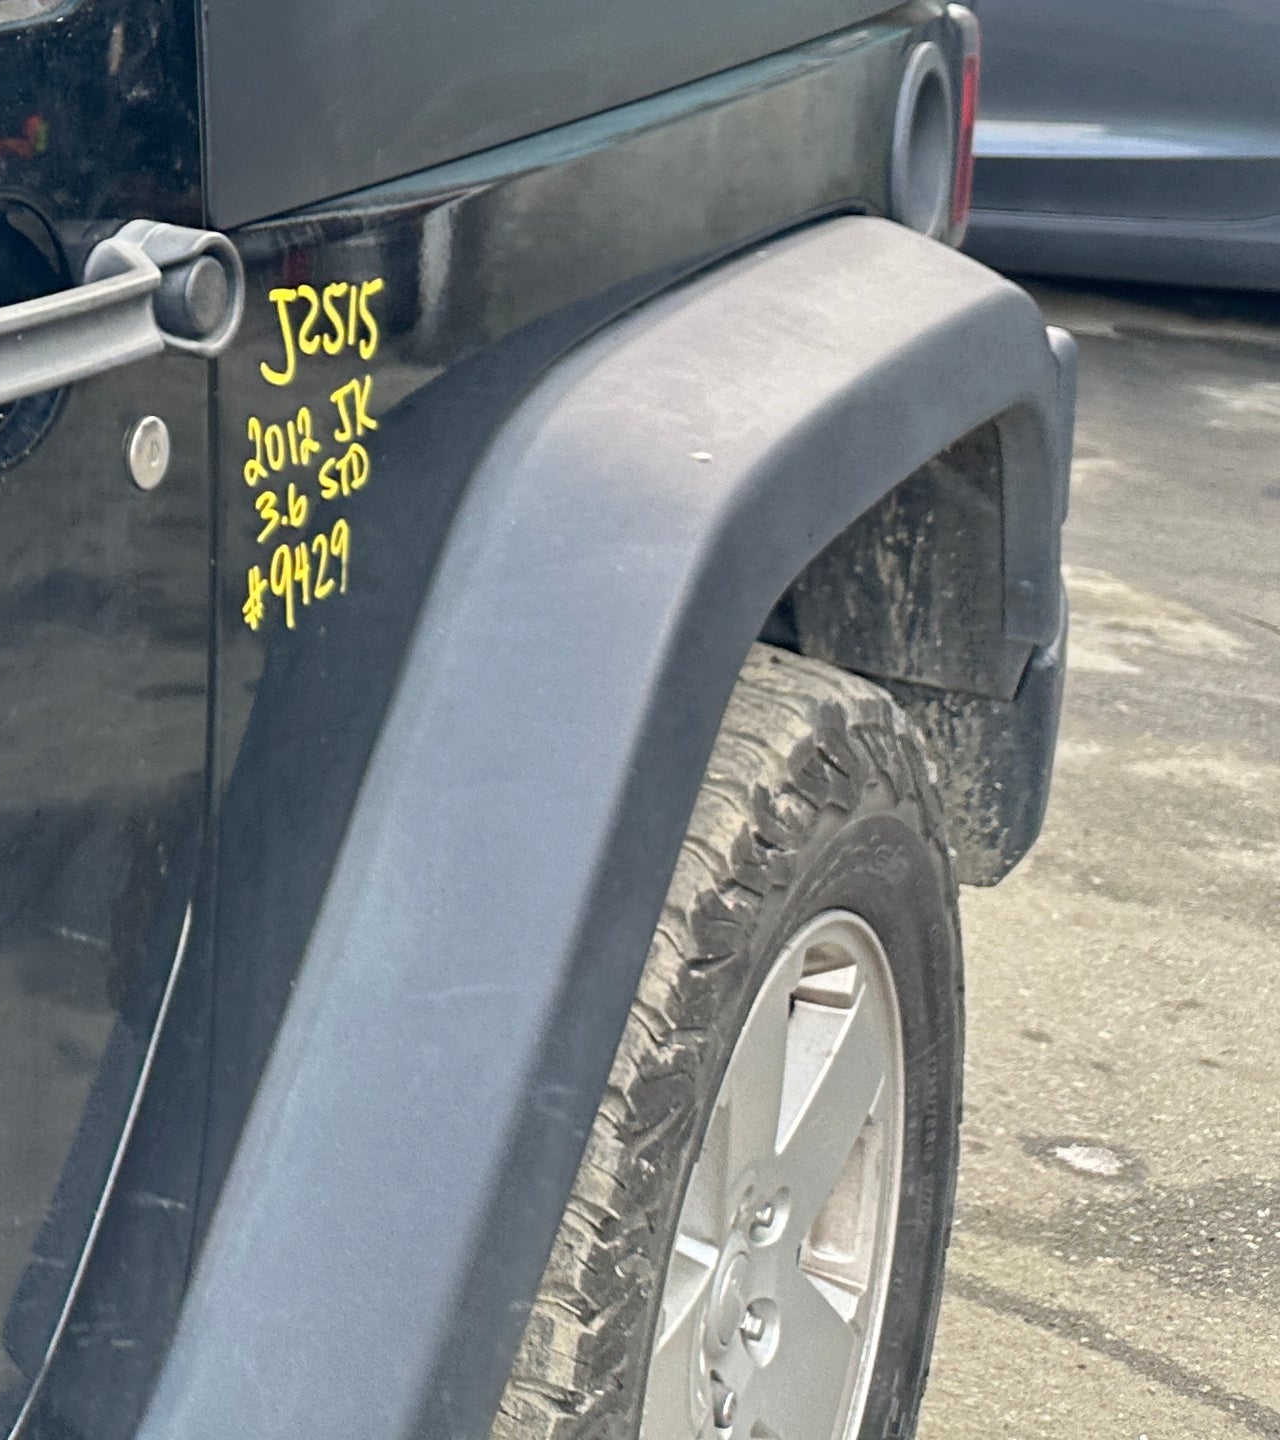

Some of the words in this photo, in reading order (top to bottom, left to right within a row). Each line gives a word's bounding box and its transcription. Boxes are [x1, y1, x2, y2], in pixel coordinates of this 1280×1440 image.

[260, 277, 385, 385] J2515
[243, 406, 321, 486] 2012
[330, 374, 379, 443] JK
[255, 482, 308, 543] 3.6
[317, 442, 372, 500] STD
[242, 518, 351, 631] #9429
